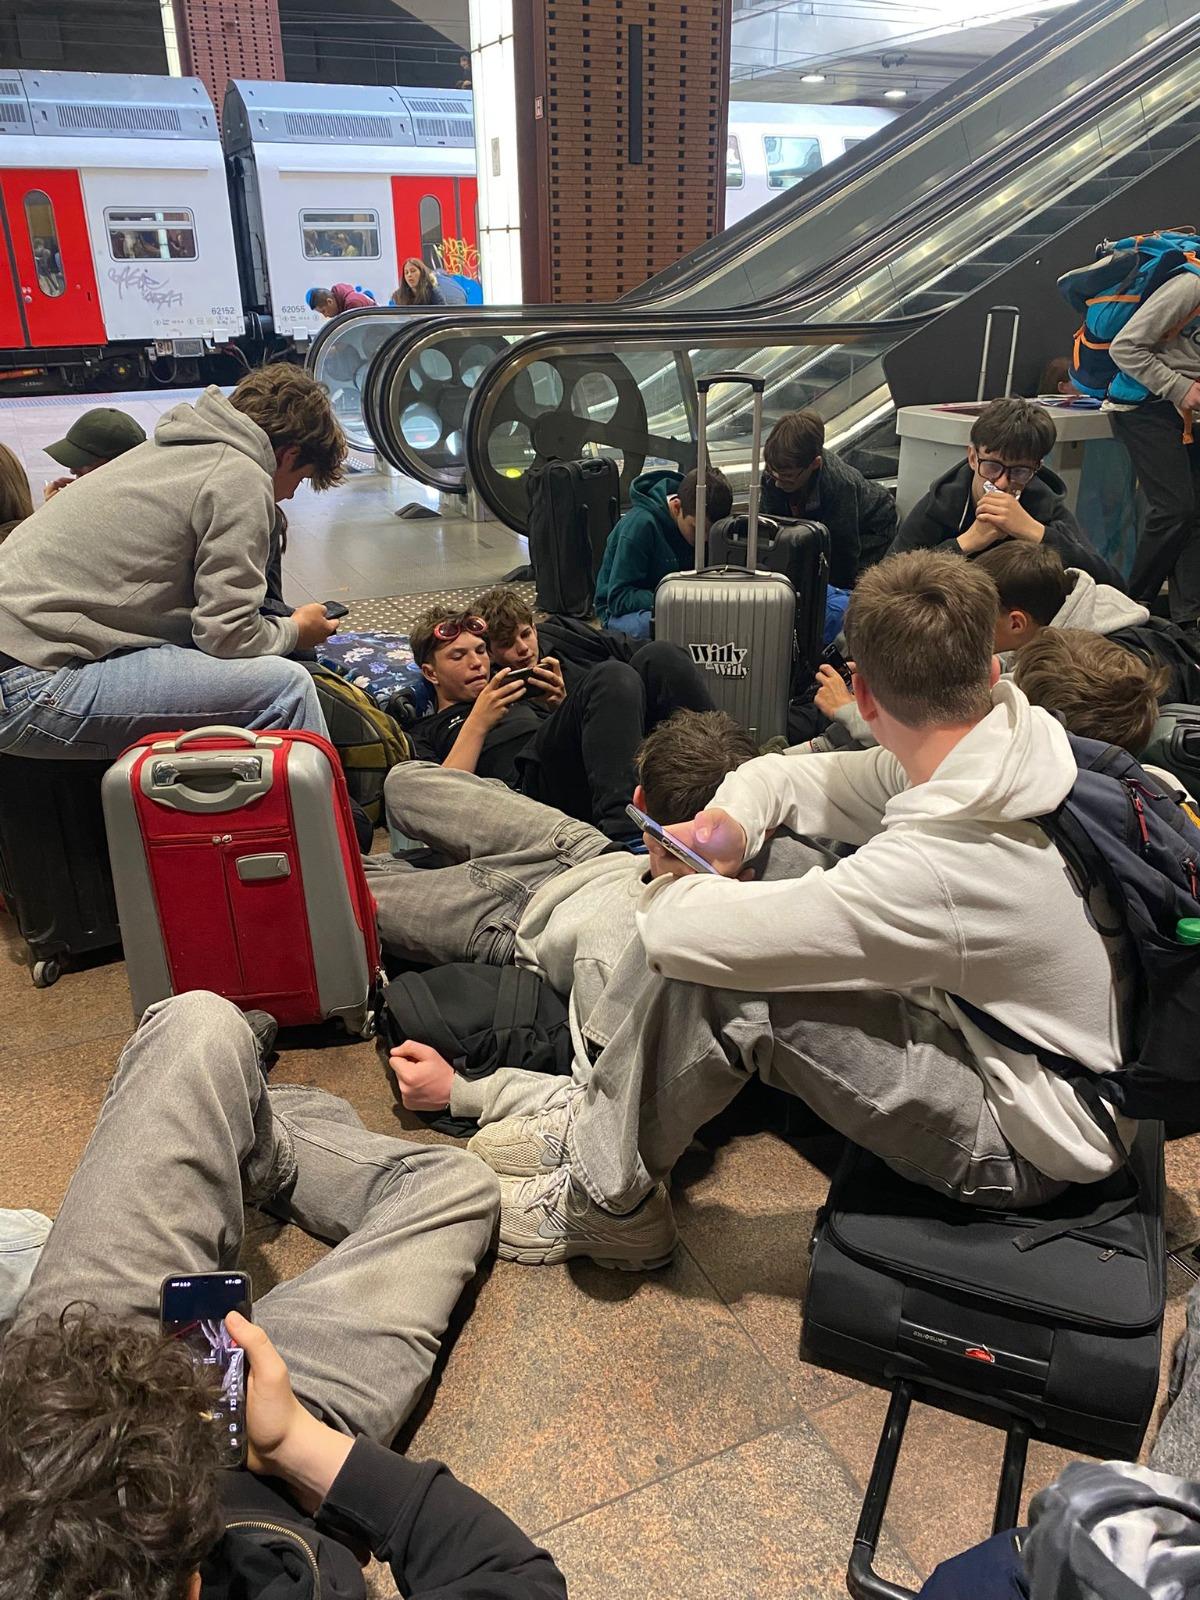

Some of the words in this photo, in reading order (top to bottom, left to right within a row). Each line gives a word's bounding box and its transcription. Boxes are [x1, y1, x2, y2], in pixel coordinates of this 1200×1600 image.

[211, 306, 235, 315] 62152
[281, 305, 306, 313] 62055
[689, 642, 747, 664] Willy
[714, 663, 750, 679] Willy
